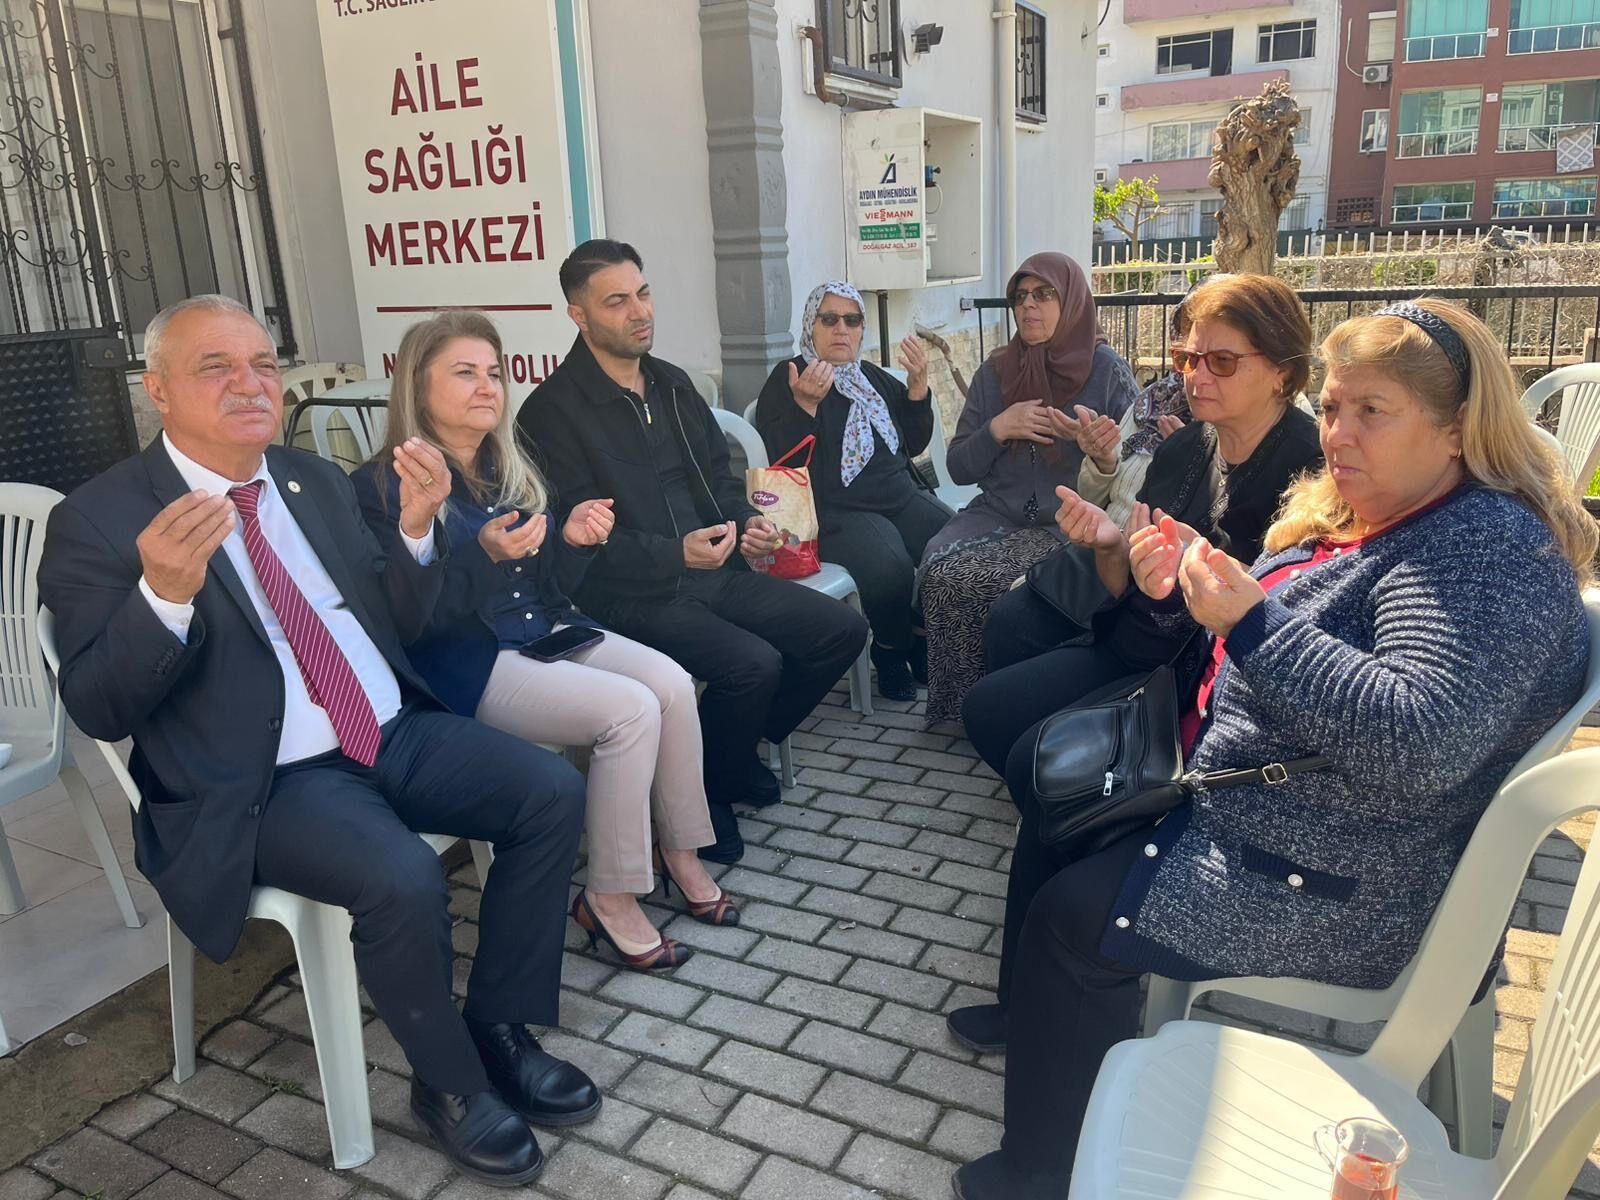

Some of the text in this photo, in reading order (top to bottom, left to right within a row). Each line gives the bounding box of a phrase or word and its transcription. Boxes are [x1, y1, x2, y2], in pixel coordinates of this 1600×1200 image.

[333, 0, 363, 17] T.C.
[390, 52, 483, 116] AİLE
[364, 124, 527, 194] SAĞLIĞI
[859, 186, 918, 200] AYDIN MÜHENDİSLİK
[364, 201, 545, 267] MERKEZİ
